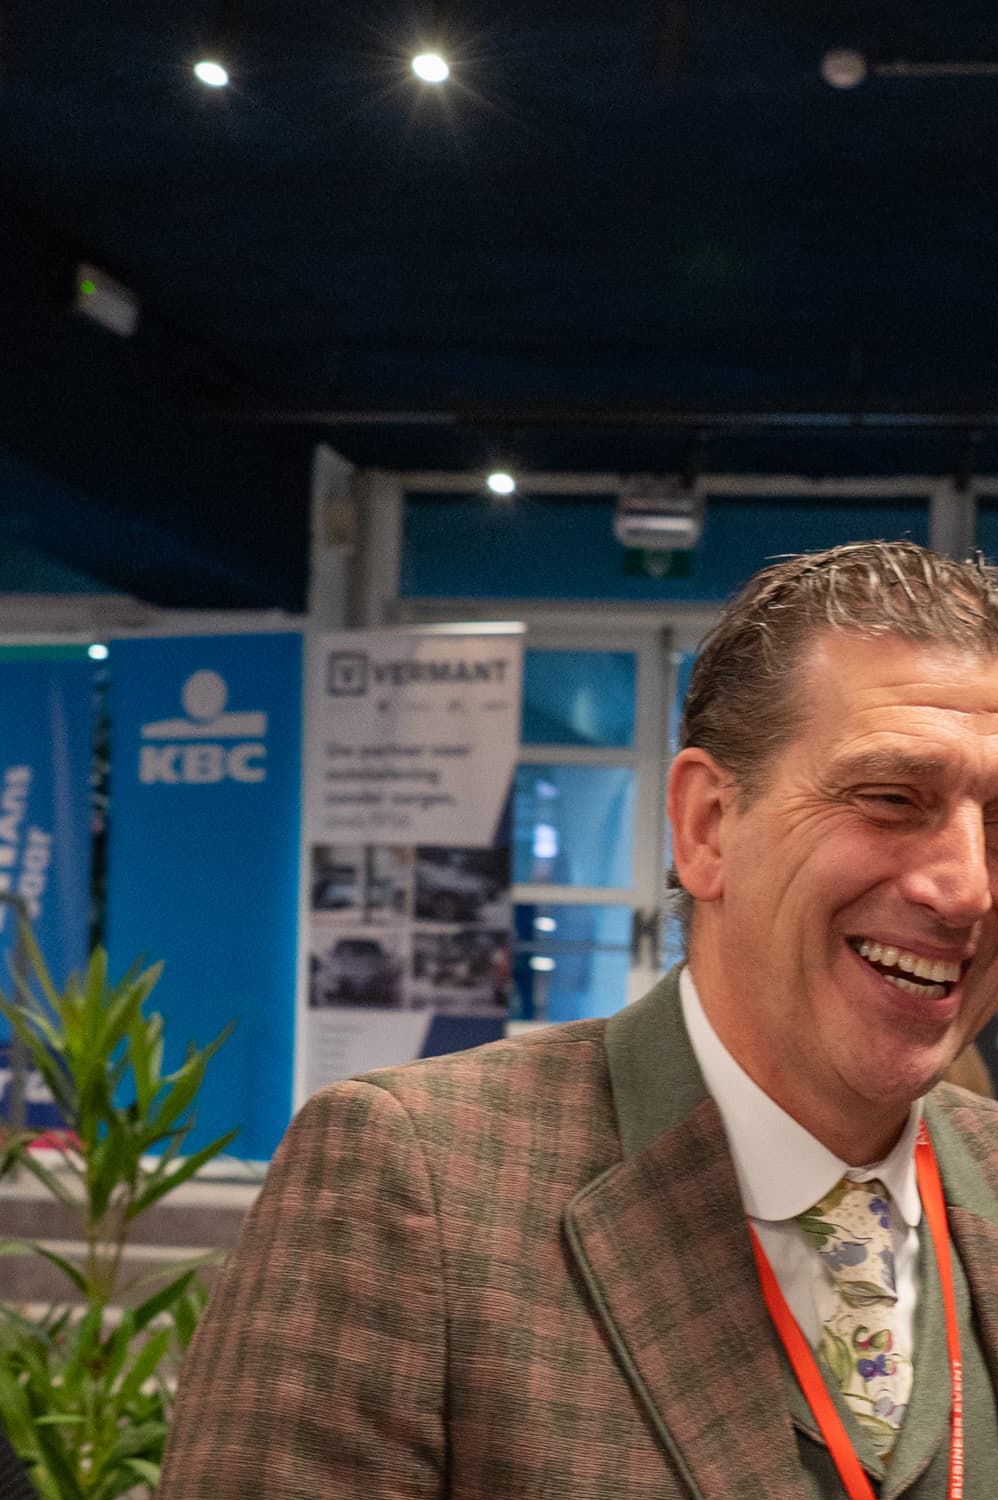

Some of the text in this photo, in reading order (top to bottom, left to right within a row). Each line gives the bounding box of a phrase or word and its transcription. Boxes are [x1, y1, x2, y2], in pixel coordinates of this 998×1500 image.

[373, 660, 508, 683] VERMANT
[139, 743, 267, 784] KBC
[951, 1361, 963, 1412] EVENT
[951, 1417, 964, 1499] BUSINESS
